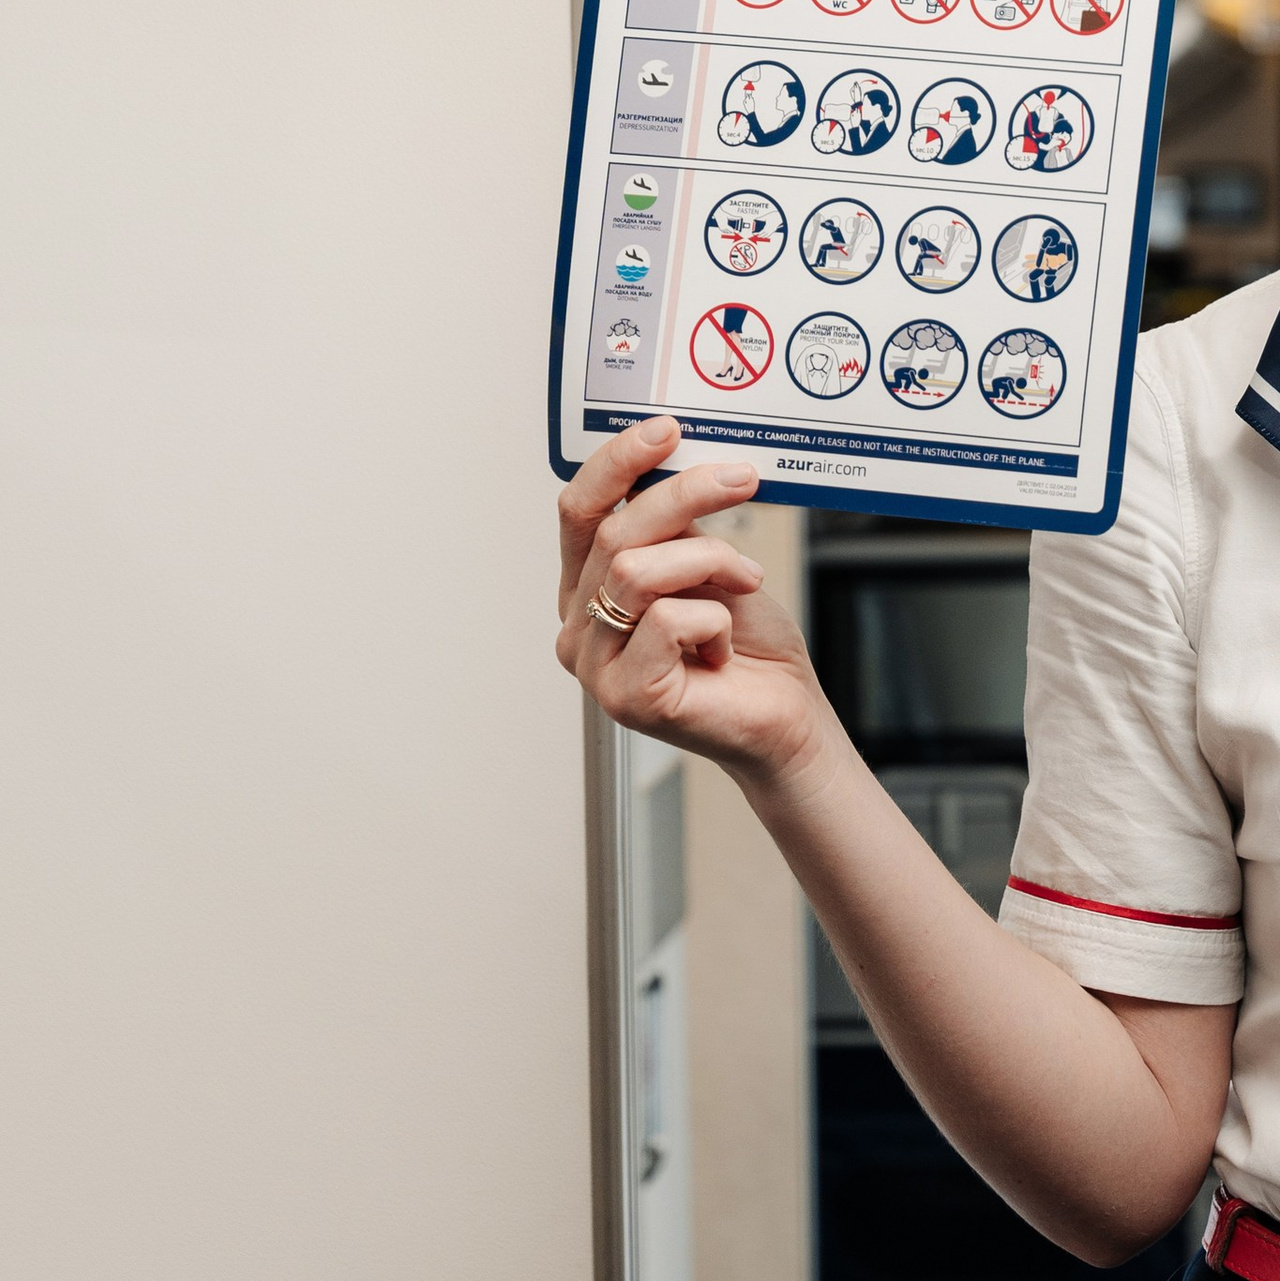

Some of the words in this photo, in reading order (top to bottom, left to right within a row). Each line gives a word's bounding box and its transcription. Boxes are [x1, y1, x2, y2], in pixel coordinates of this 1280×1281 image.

[832, 0, 847, 8] WC
[617, 112, 682, 124] РАЗГЕРМЕТИЗАЦИЯ
[619, 122, 678, 133] DEPRESSURIZATION
[729, 200, 768, 208] ЗАСТЕГНИТЕ
[813, 323, 848, 332] ЗАЩИТИТЕ
[799, 327, 831, 336] КОЖНЫЙ
[833, 330, 860, 339] ПОКРОВ
[740, 336, 767, 345] НЕЙЛОН
[800, 335, 824, 343] PROTECT
[695, 424, 754, 438] ИНСТРУКЦИЮ
[756, 430, 762, 439] С
[764, 431, 810, 444] САМОЛЁТА
[817, 436, 846, 447] PLEASE
[848, 439, 861, 448] DO
[863, 440, 879, 450] NOT
[883, 442, 902, 452] TAKE
[906, 444, 920, 454] THE
[922, 446, 981, 460] INSTRUCTIONS
[983, 452, 998, 462] OFF
[1001, 454, 1016, 464] THE
[1018, 455, 1046, 466] PLANE.
[776, 455, 867, 476] azurair.com
